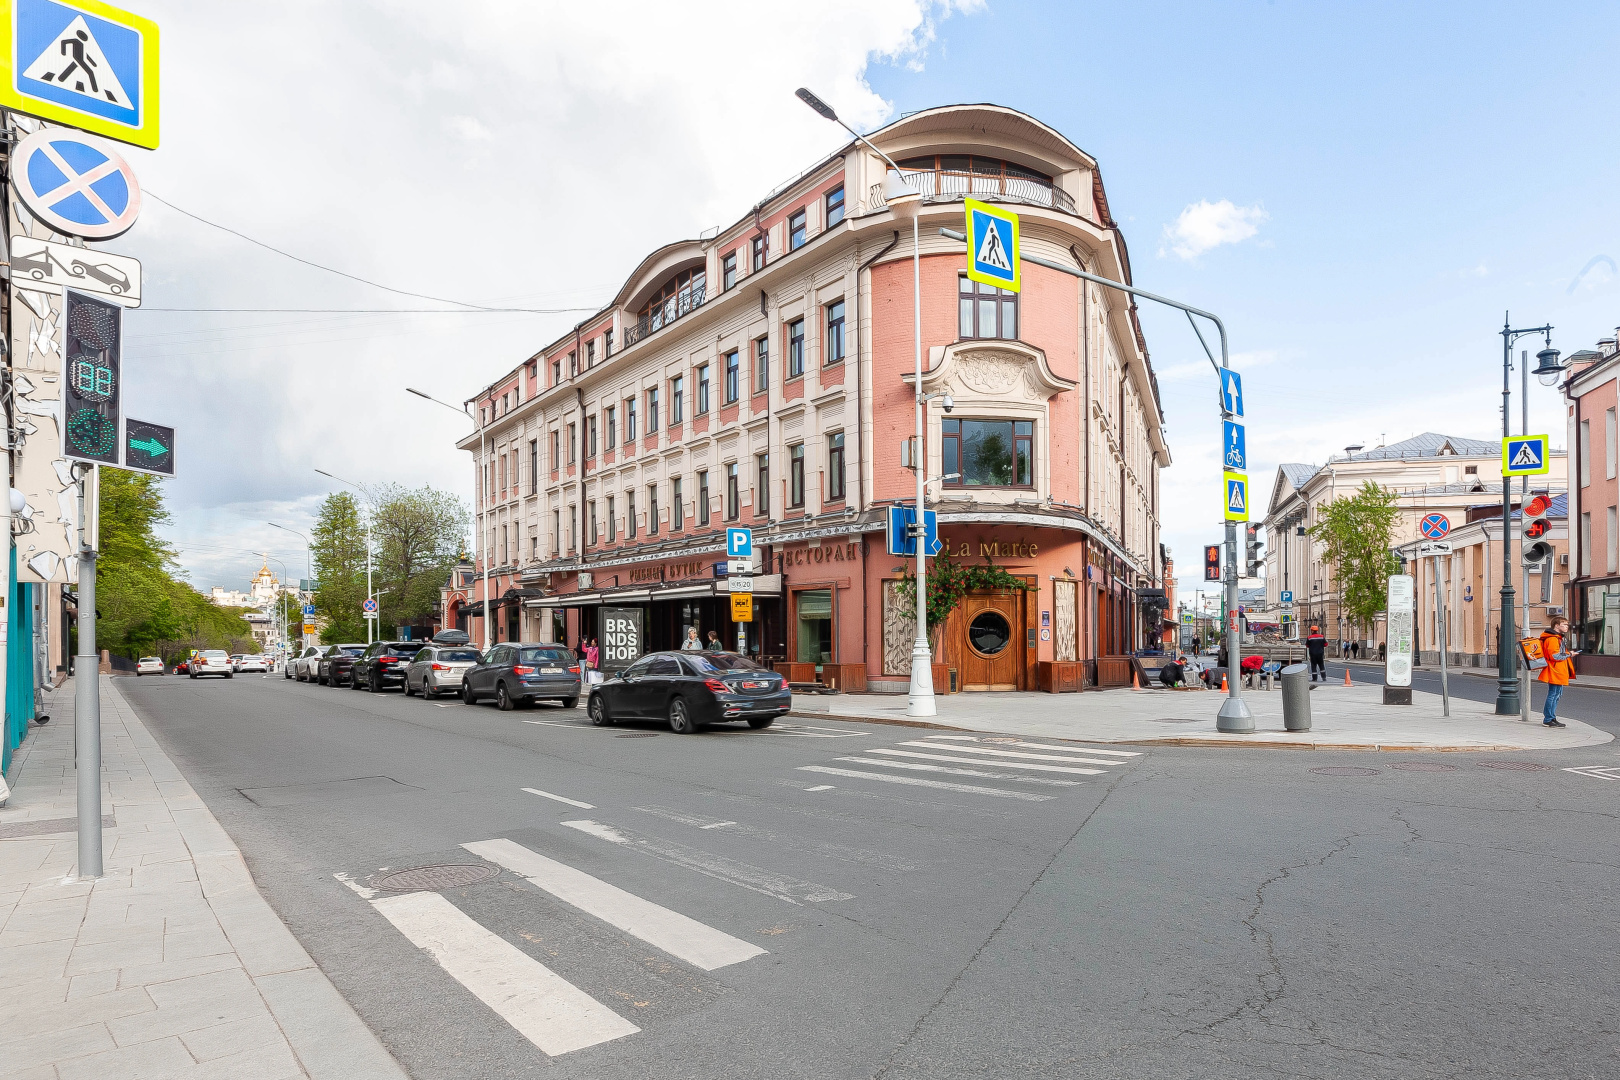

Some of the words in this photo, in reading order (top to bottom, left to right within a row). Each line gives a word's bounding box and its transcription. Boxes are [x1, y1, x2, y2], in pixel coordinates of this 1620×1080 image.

[79, 361, 112, 396] 32
[733, 532, 748, 553] P
[945, 537, 972, 557] La
[669, 561, 703, 577] БУТИК
[1283, 592, 1291, 601] P
[306, 606, 313, 614] P
[605, 618, 637, 632] BRA
[605, 632, 637, 646] NDS
[605, 646, 638, 660] HOP
